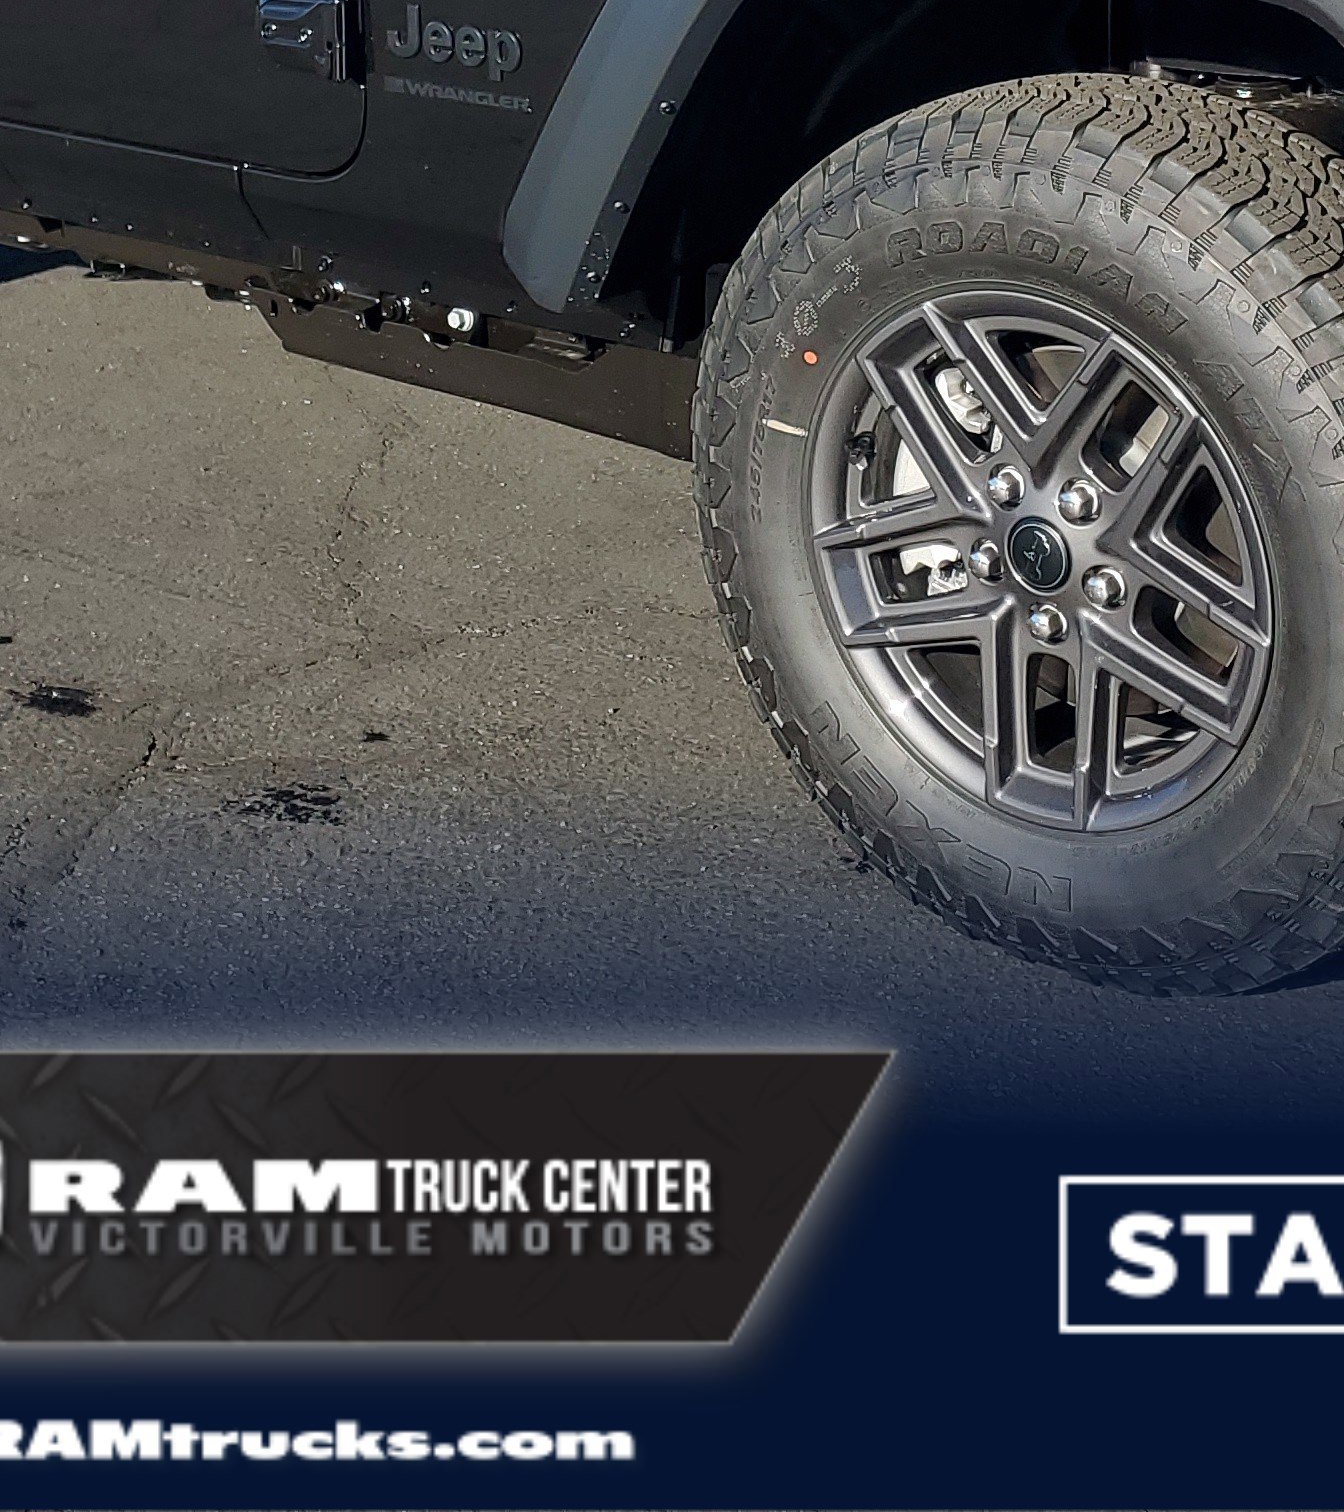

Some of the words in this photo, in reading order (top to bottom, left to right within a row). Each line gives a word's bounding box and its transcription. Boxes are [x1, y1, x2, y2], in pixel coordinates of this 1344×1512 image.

[386, 2, 523, 82] Jeep
[405, 79, 534, 113] WRANGLER
[885, 219, 1188, 336] ROADIAN
[808, 699, 1072, 913] NEXEN
